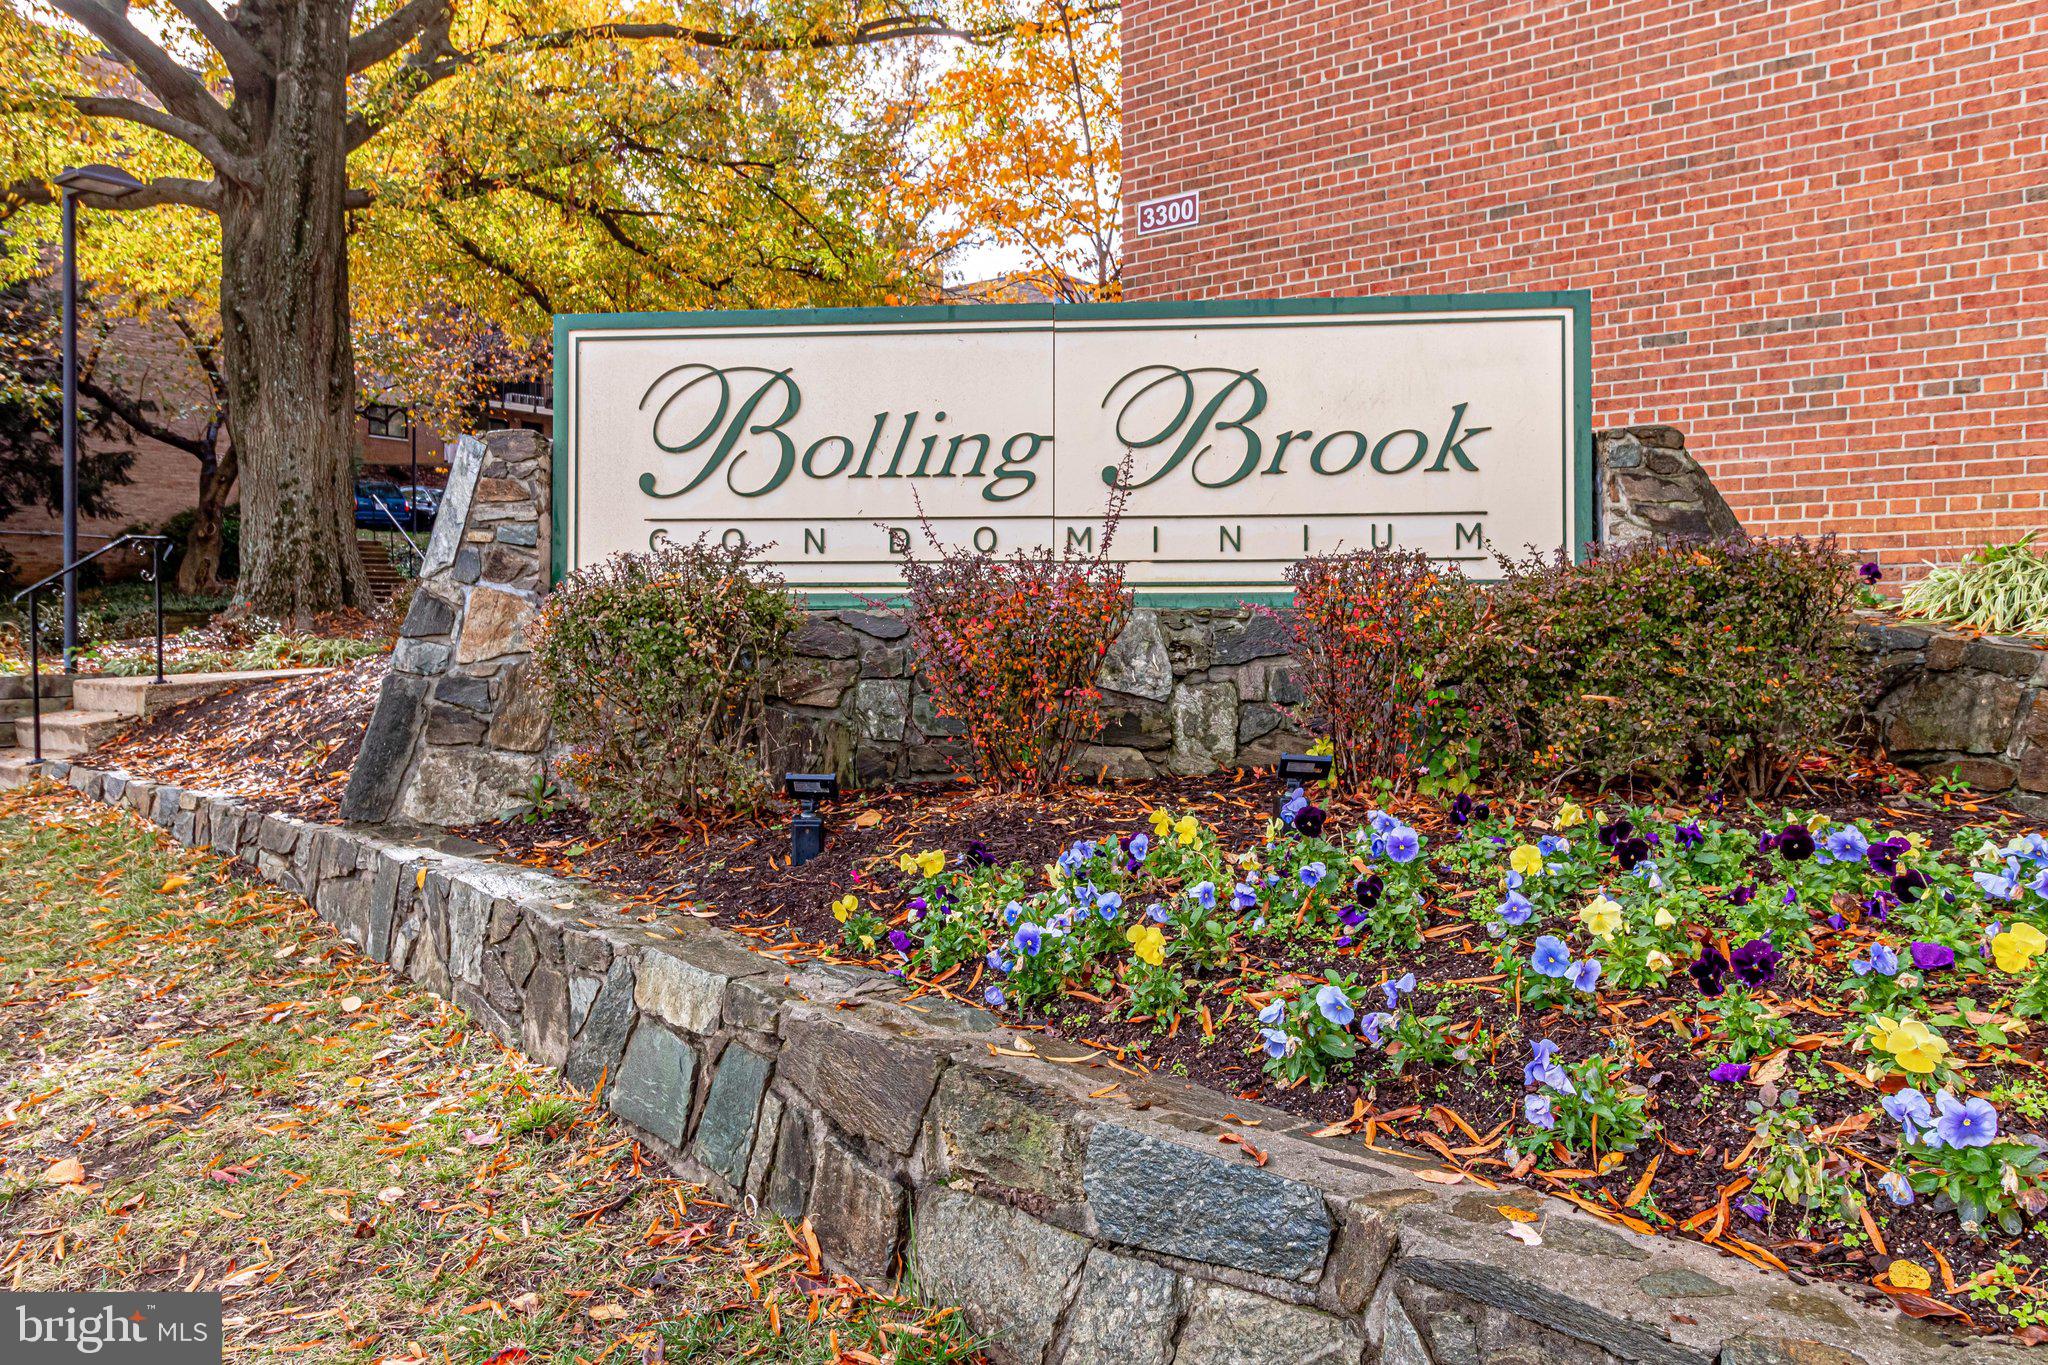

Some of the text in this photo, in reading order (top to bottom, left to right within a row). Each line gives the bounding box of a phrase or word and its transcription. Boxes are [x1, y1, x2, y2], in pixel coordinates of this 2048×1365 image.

[1143, 199, 1193, 228] 3300
[639, 363, 1492, 501] Bolling Brook
[649, 522, 1482, 555] CONDOMINIUM
